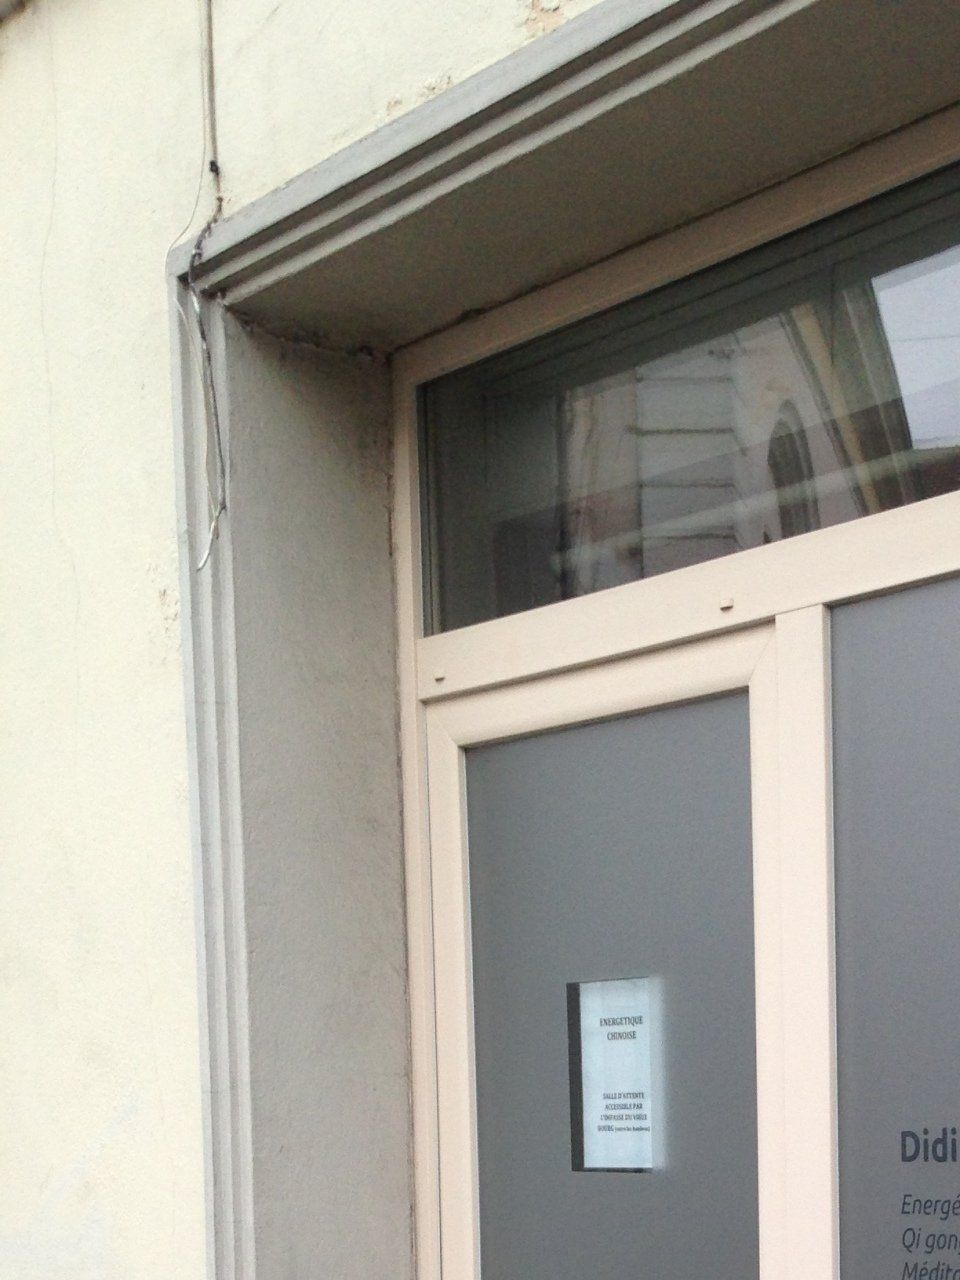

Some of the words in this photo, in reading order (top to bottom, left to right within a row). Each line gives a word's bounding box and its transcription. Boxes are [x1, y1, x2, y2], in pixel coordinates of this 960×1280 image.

[600, 1016, 644, 1027] ENERGETIQUE
[606, 1030, 637, 1040] CHINOISE
[902, 1228, 922, 1253] Qi
